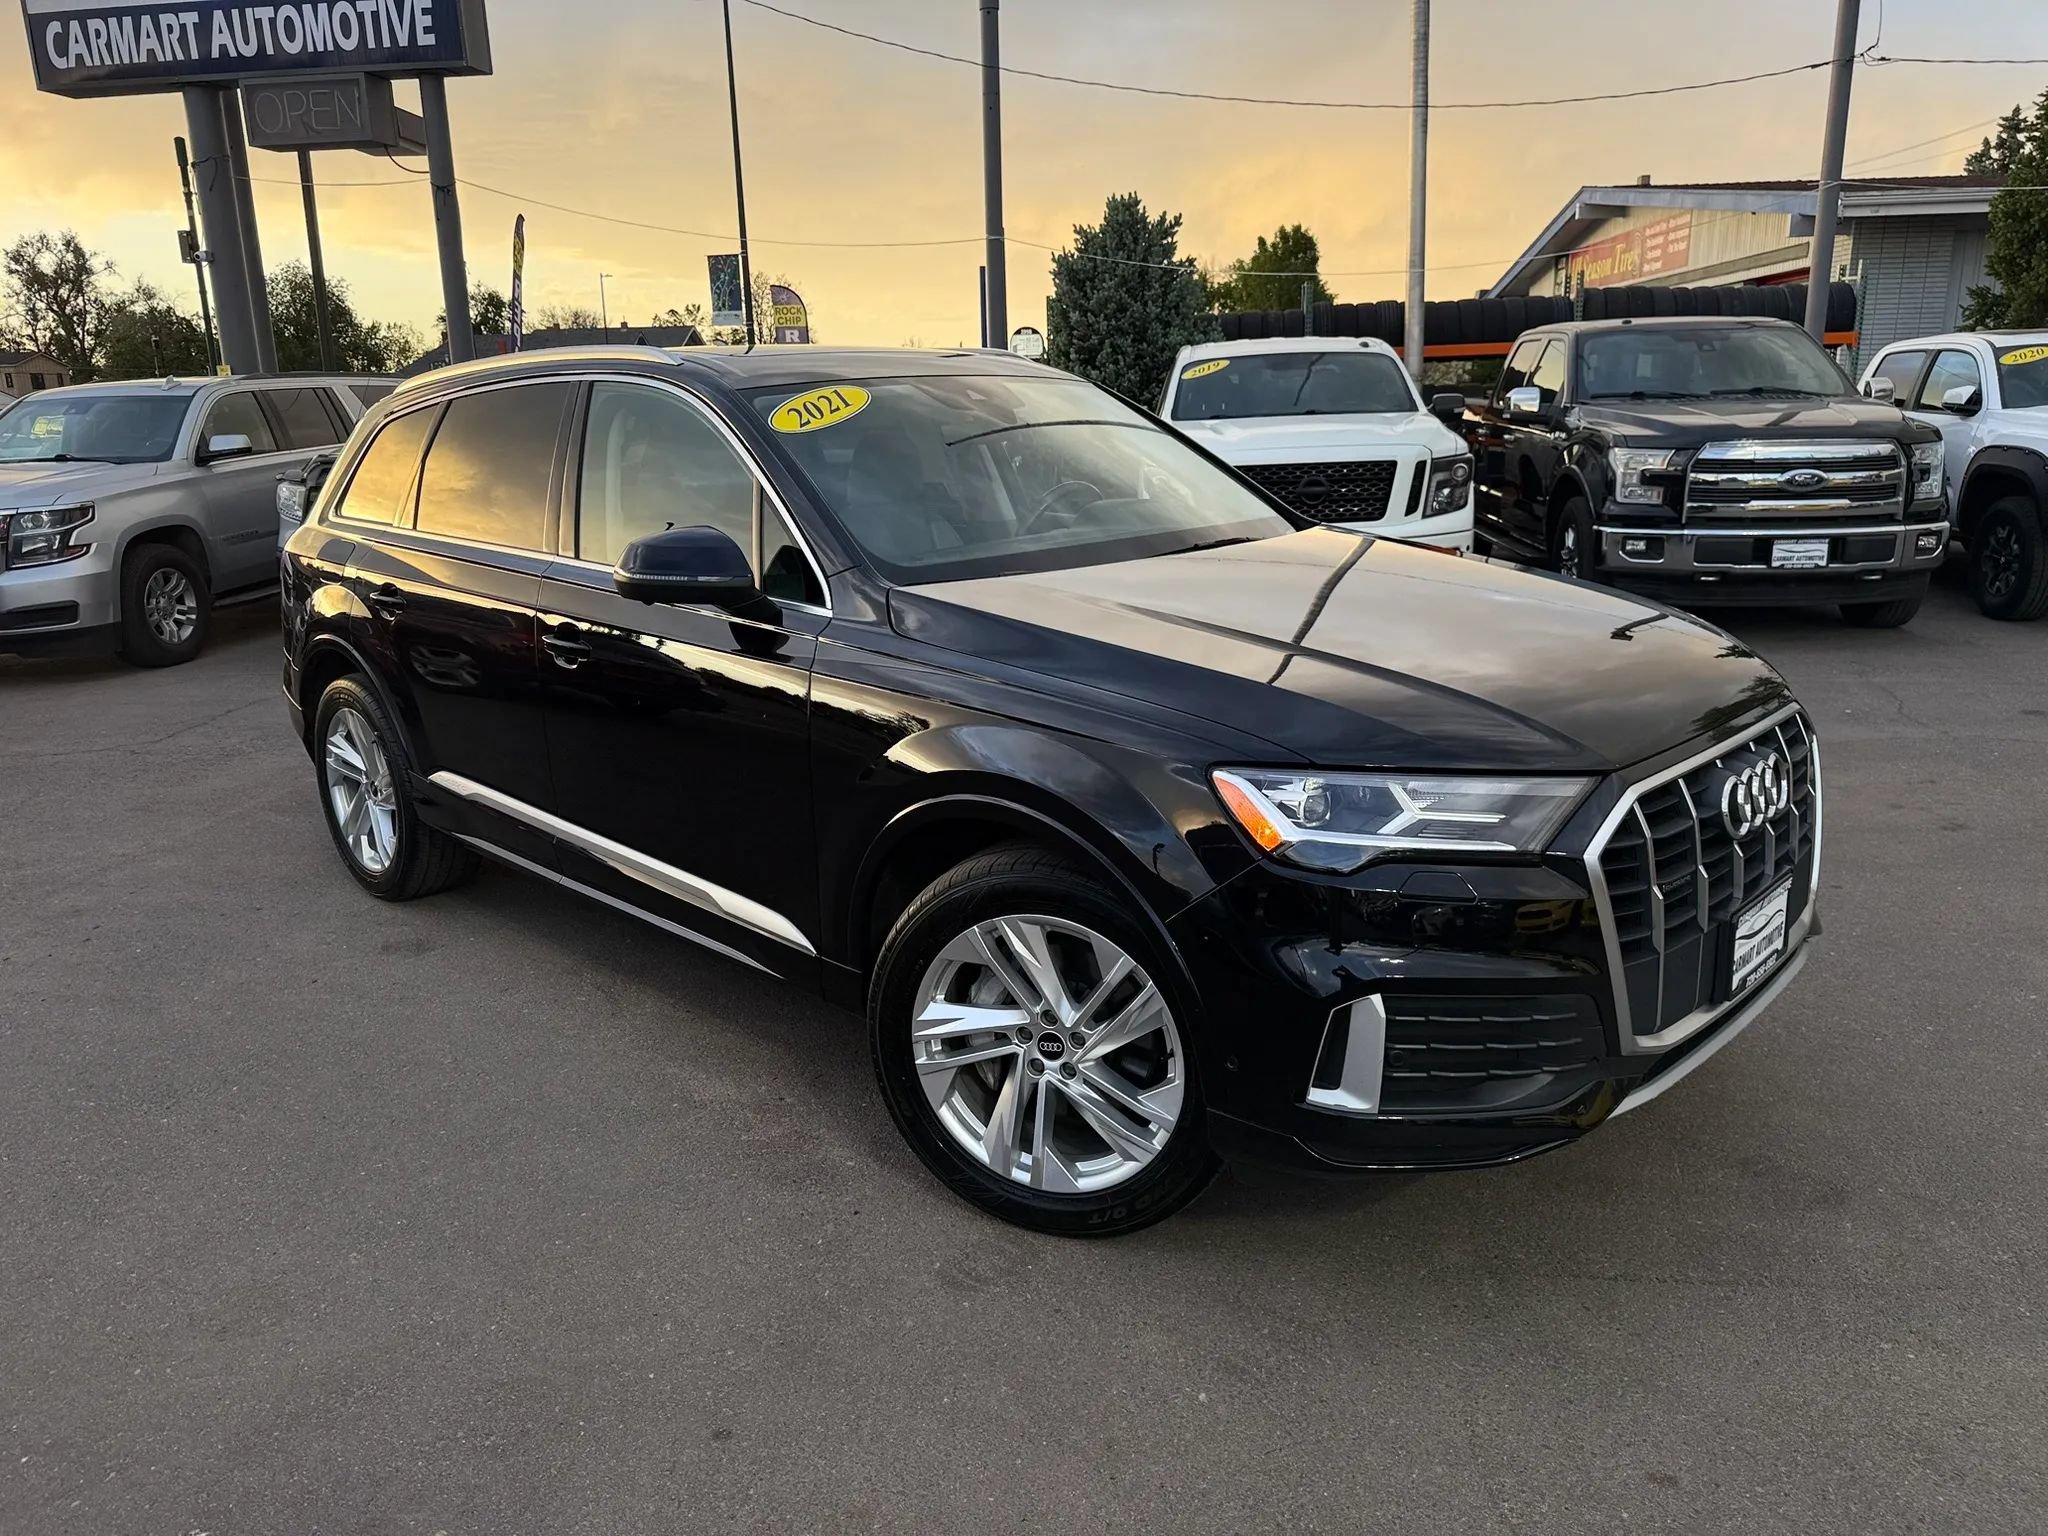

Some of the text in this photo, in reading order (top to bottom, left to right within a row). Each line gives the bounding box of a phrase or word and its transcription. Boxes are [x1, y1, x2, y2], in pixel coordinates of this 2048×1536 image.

[45, 0, 437, 70] CARMART AUTOMOTIVE
[255, 87, 362, 134] OPEN
[774, 306, 802, 316] ROCK
[777, 316, 802, 326] CHIP
[2010, 347, 2045, 363] 2020
[1191, 361, 1220, 377] 2019
[786, 389, 853, 428] 2021
